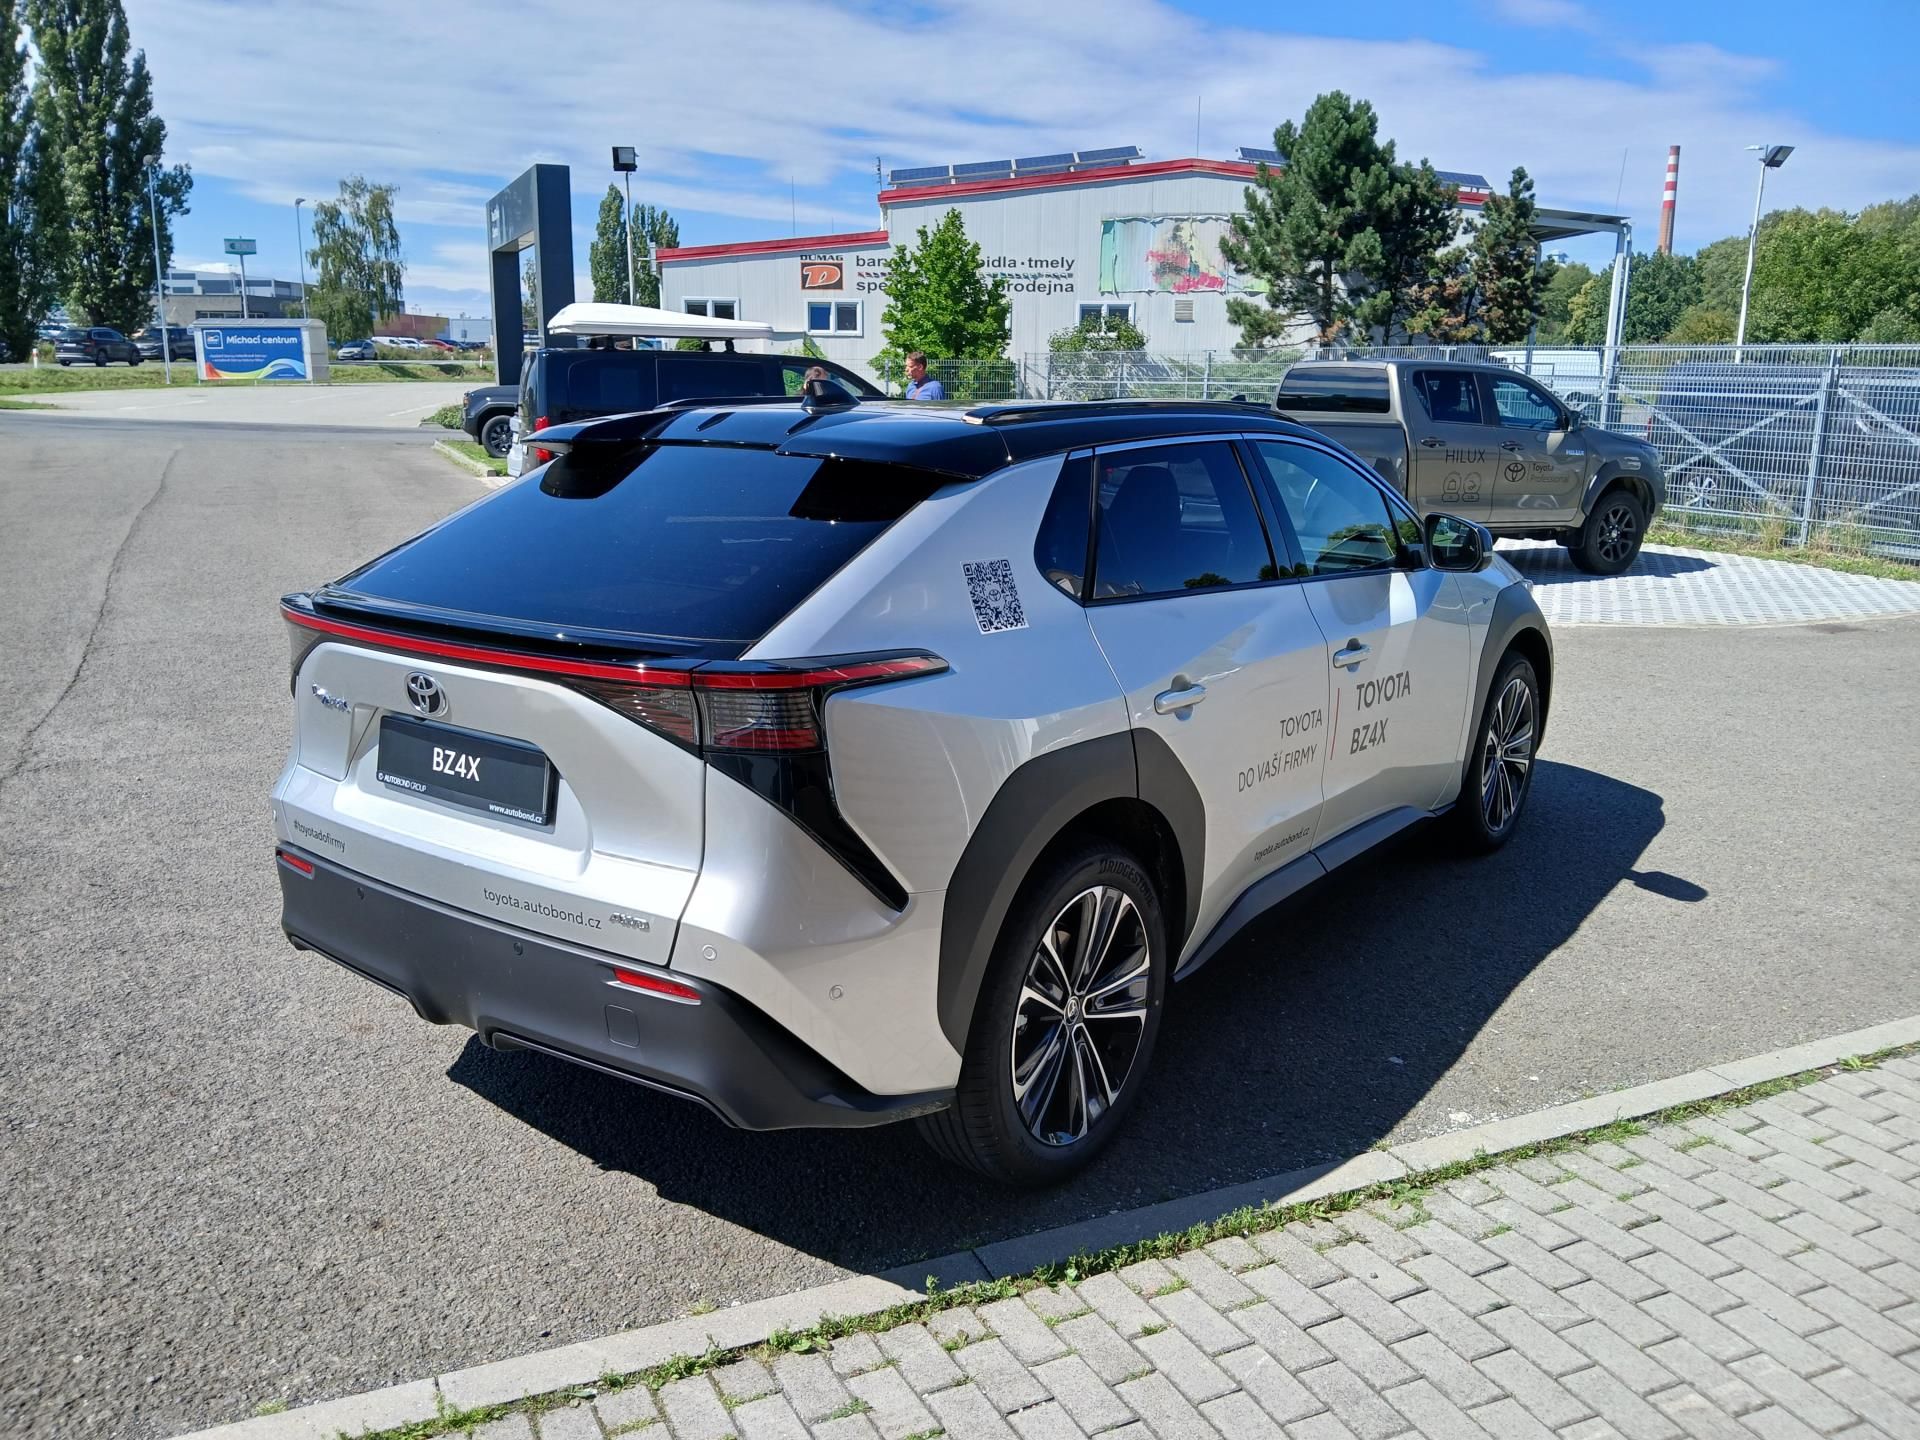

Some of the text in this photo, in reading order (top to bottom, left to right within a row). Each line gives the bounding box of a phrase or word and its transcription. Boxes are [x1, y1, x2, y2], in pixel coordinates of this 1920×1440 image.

[1027, 256, 1075, 271] tmely
[262, 335, 298, 344] centrum
[1445, 448, 1486, 464] HILUX
[1533, 463, 1554, 474] Toyota
[1356, 670, 1411, 711] TOYOTA
[1280, 708, 1323, 739] TOYOTA
[1349, 717, 1389, 755] BZ4X
[432, 747, 481, 781] BZ4X
[1238, 743, 1318, 793] DO VAŠÍ FIRMY
[383, 774, 427, 793] AUTOBOND GROUP
[488, 803, 543, 824] www.autobond.cz
[293, 820, 346, 853] #toyotadofirmy
[1253, 827, 1310, 864] toyota.autobond.cz
[484, 888, 603, 930] toyota.autobond.cz
